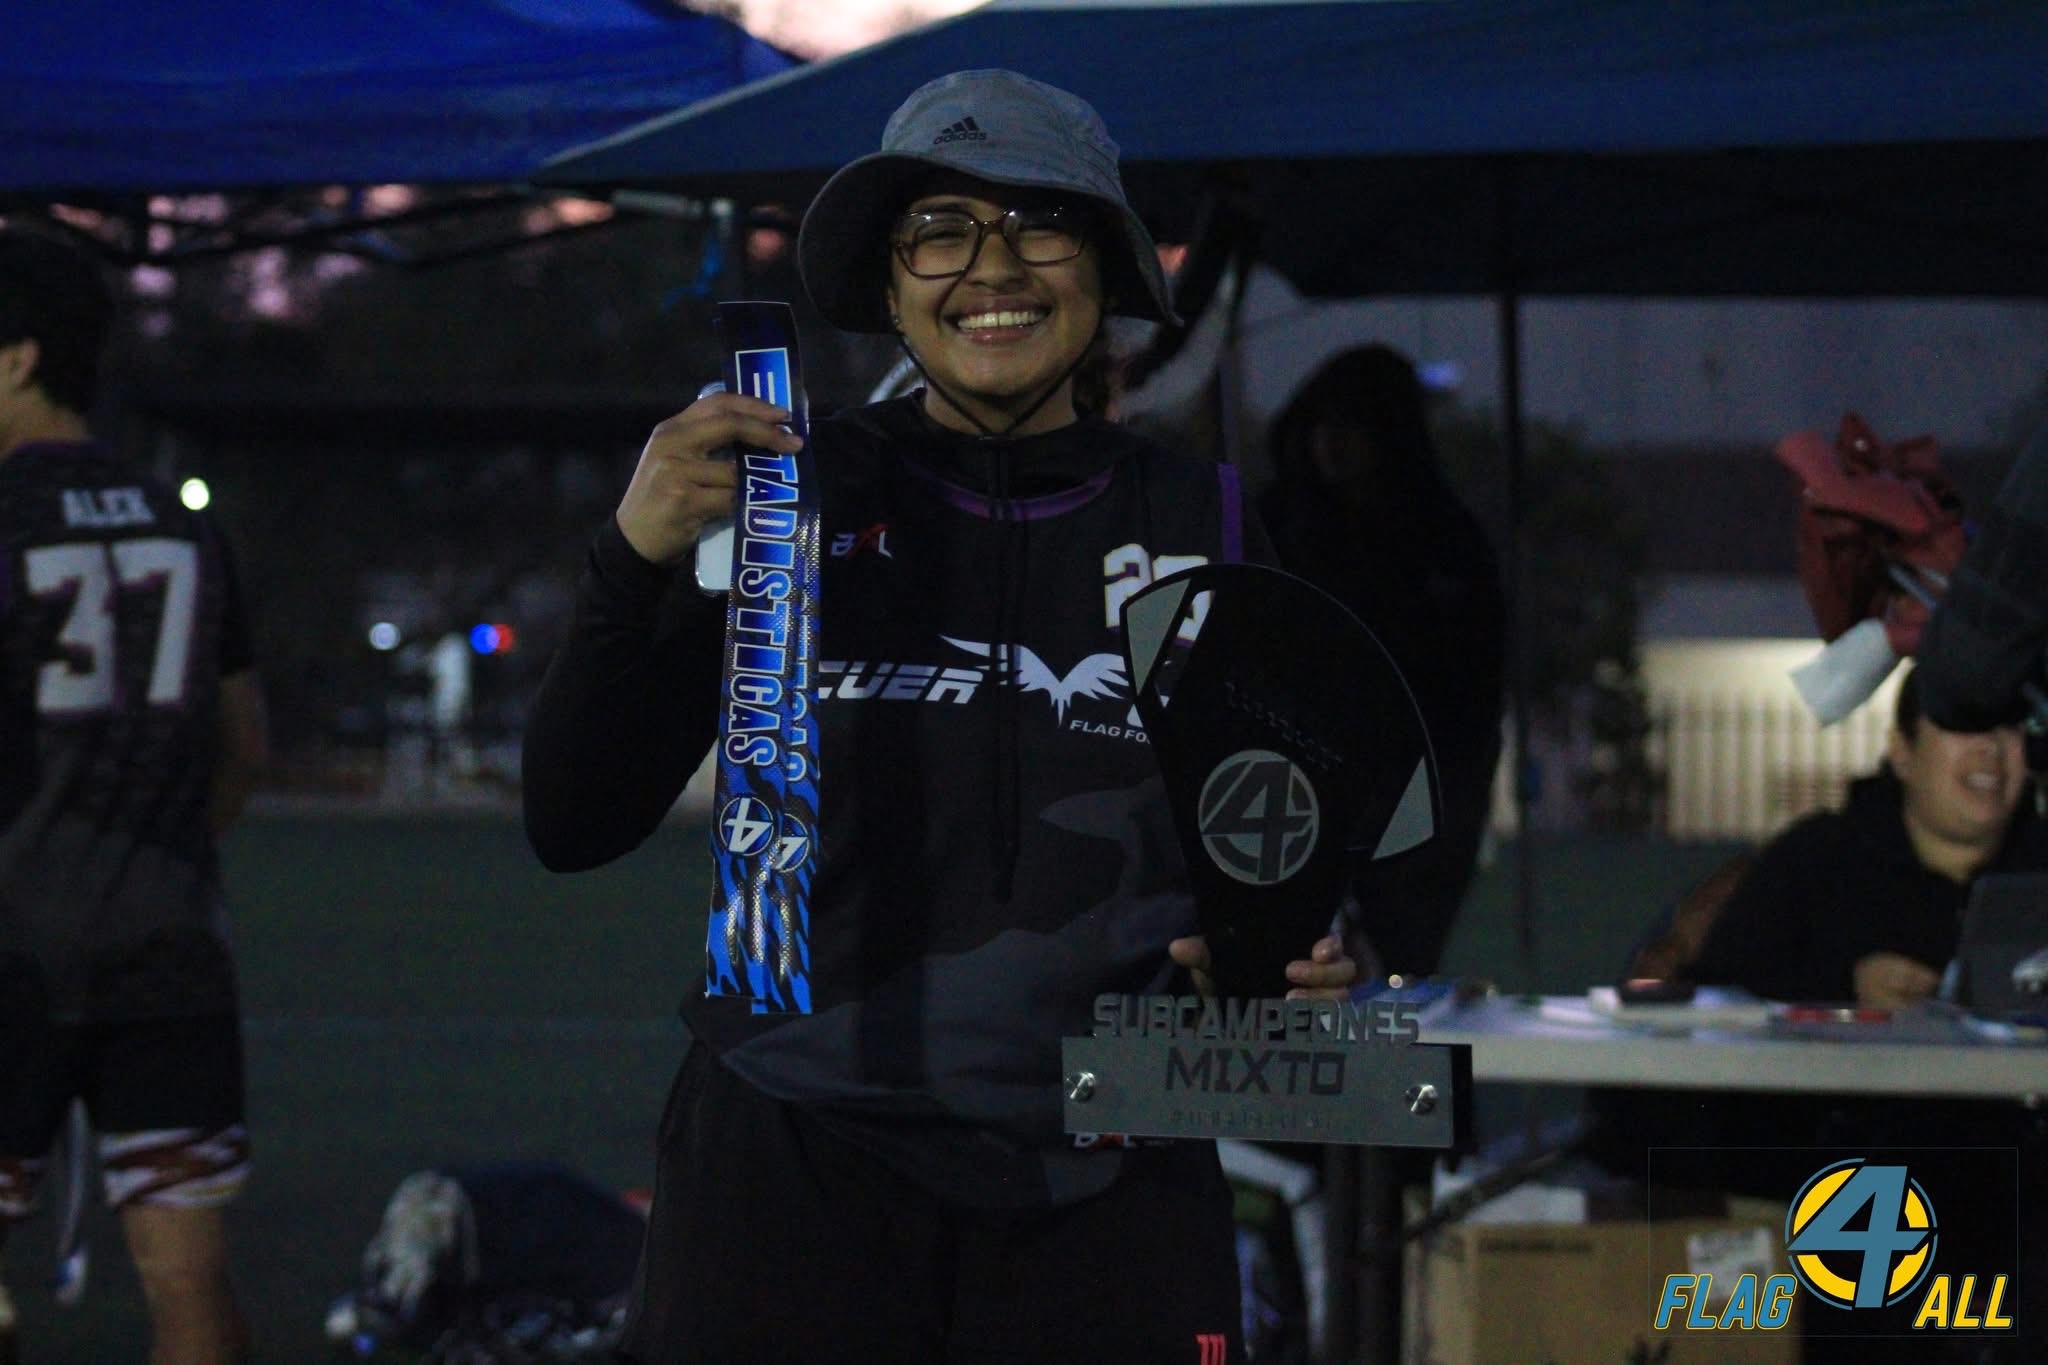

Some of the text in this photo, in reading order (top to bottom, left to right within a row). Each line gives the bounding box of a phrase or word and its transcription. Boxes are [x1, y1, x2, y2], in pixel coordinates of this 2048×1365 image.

[933, 129, 987, 145] adidas
[725, 347, 799, 767] ETADISTICAS
[23, 536, 199, 714] 37
[1070, 719, 1151, 745] FLAG FO
[1093, 991, 1420, 1045] SUBCAMPEONES
[1165, 1047, 1346, 1095] MIXTO
